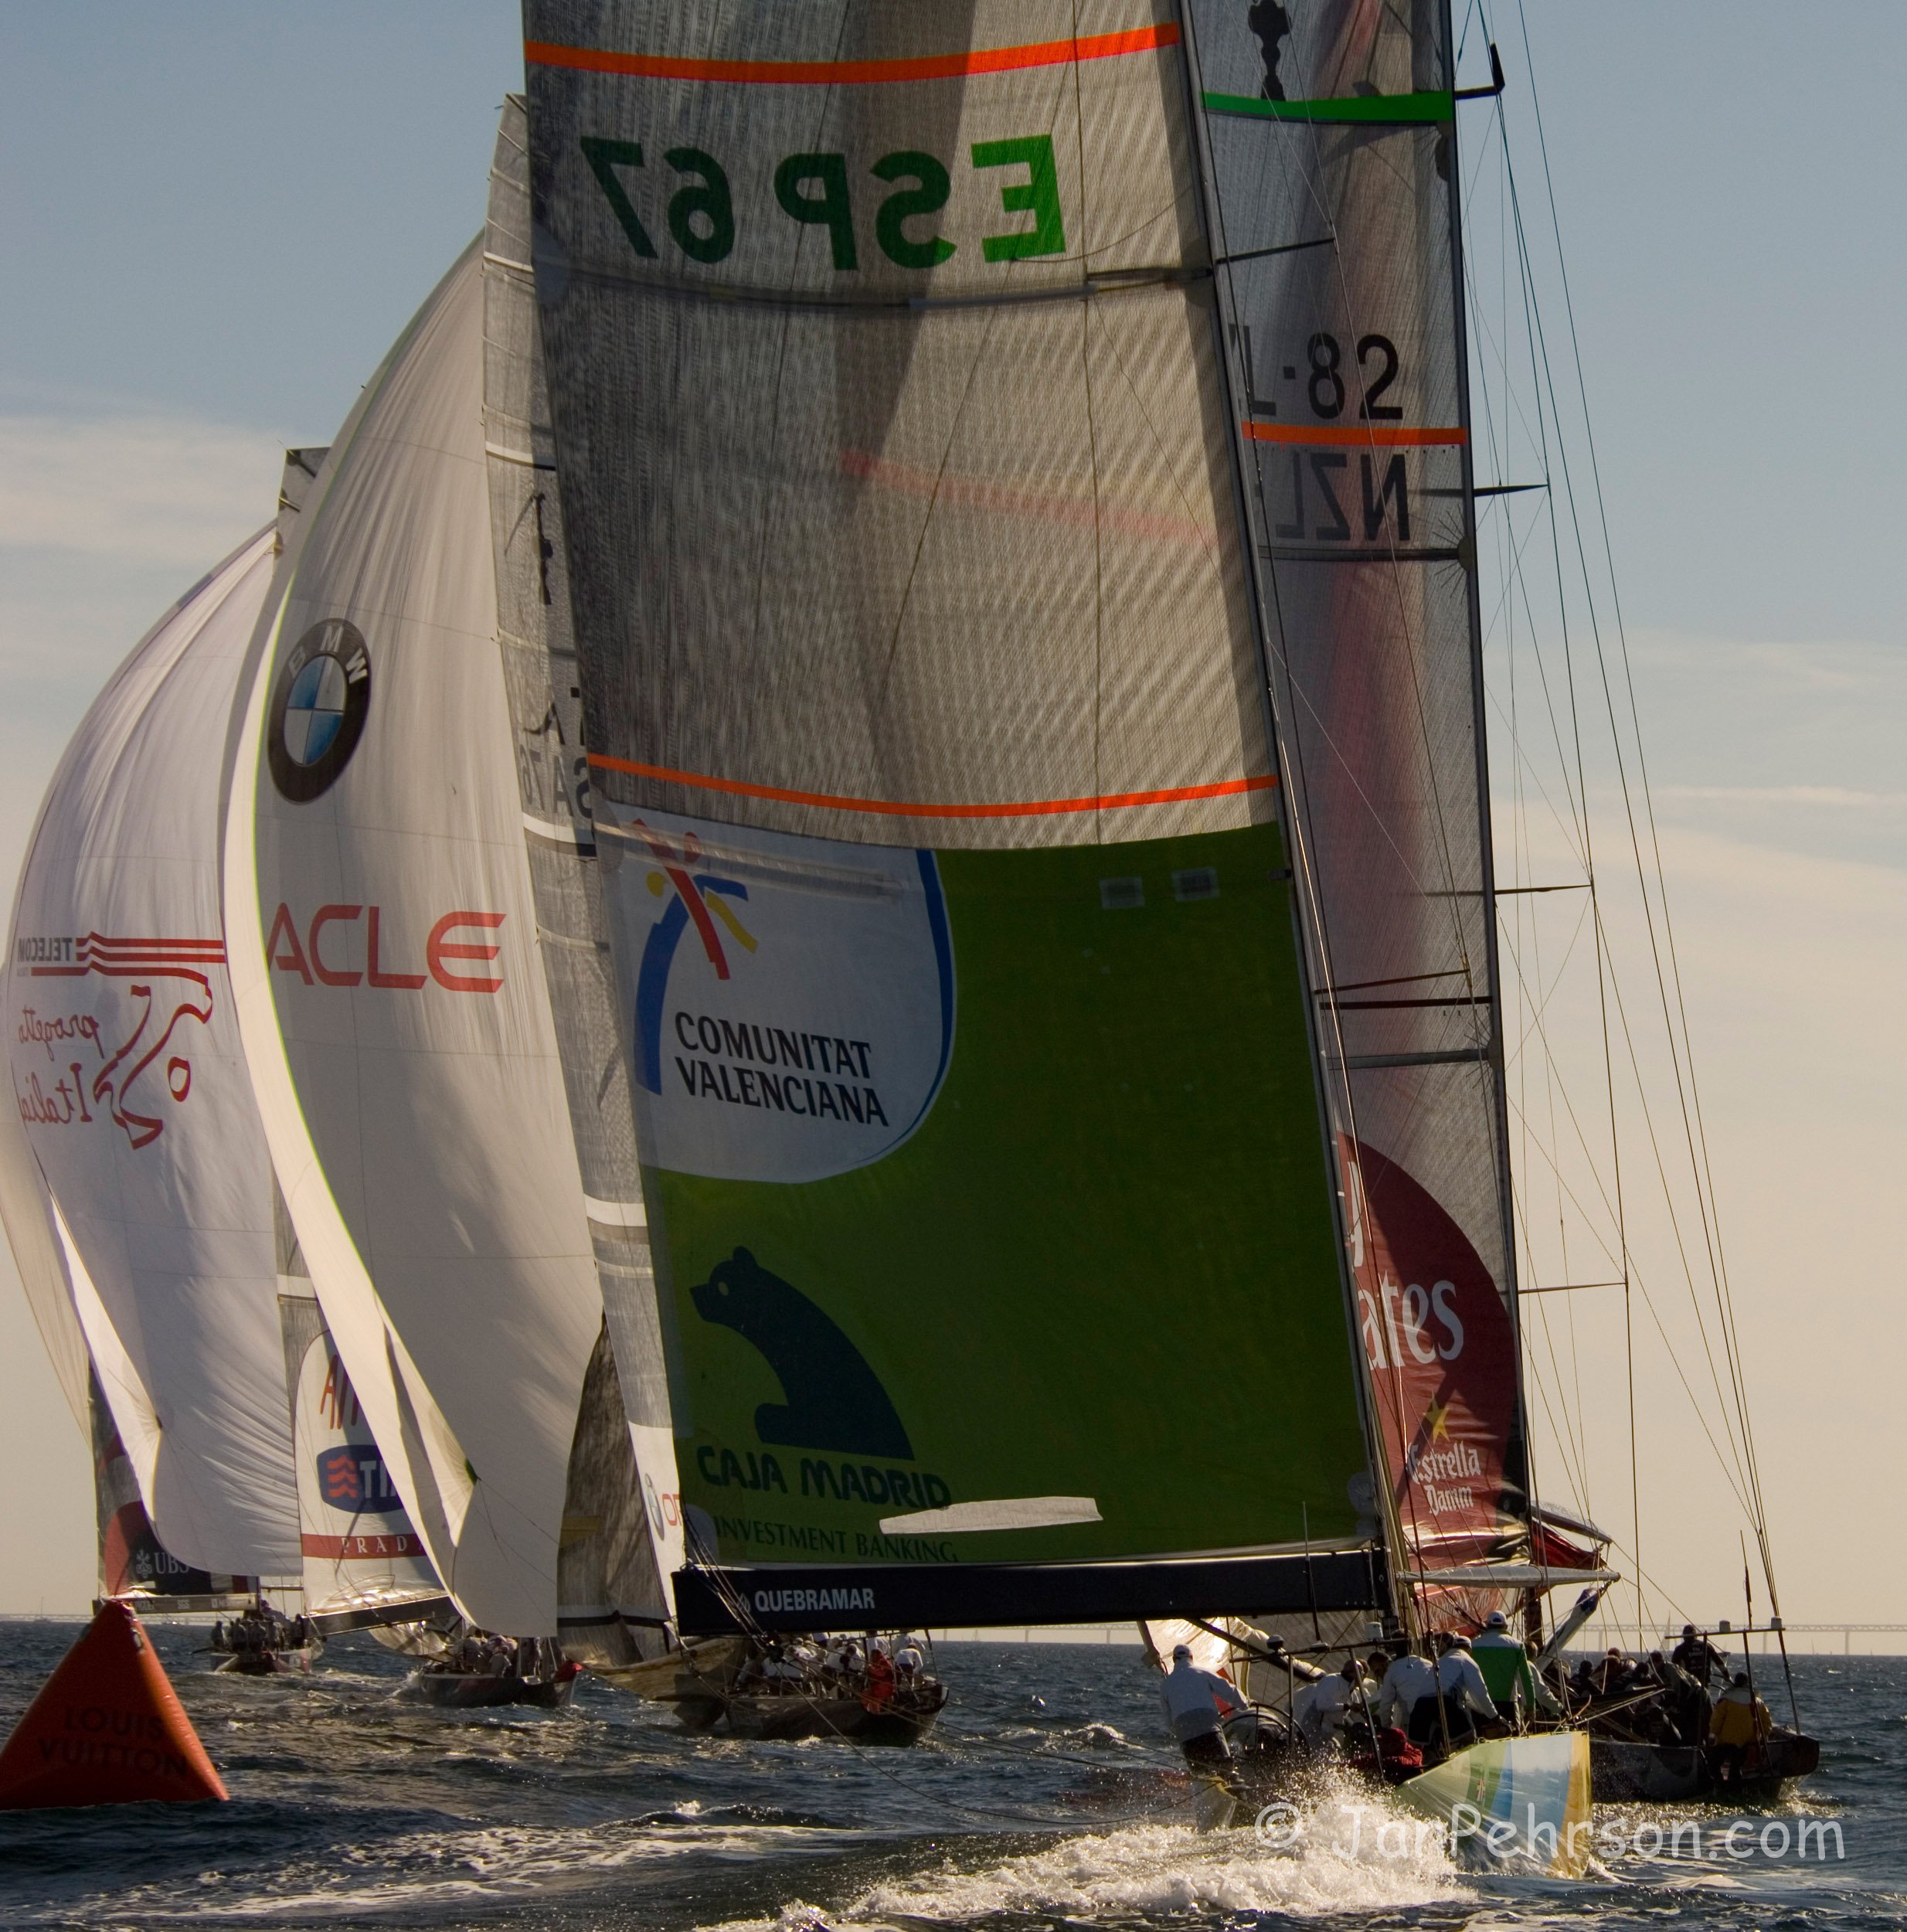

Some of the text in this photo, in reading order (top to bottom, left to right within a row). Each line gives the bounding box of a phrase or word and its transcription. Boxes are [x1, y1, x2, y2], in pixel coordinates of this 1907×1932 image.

[288, 625, 369, 685] BMW
[266, 902, 507, 994] ACLE
[674, 1011, 872, 1080] COMUNITAT
[674, 1056, 889, 1128] VALENCIANA
[359, 1460, 396, 1498] TI
[697, 1445, 952, 1509] CAJA MADRID
[1406, 1440, 1481, 1485] Estrella
[1423, 1485, 1474, 1516] Damm
[713, 1515, 959, 1563] INVESTMENT BANKING
[754, 1587, 875, 1613] QUEBRAMAR
[64, 1706, 165, 1740] LOUIS
[39, 1737, 189, 1777] VUITTON
